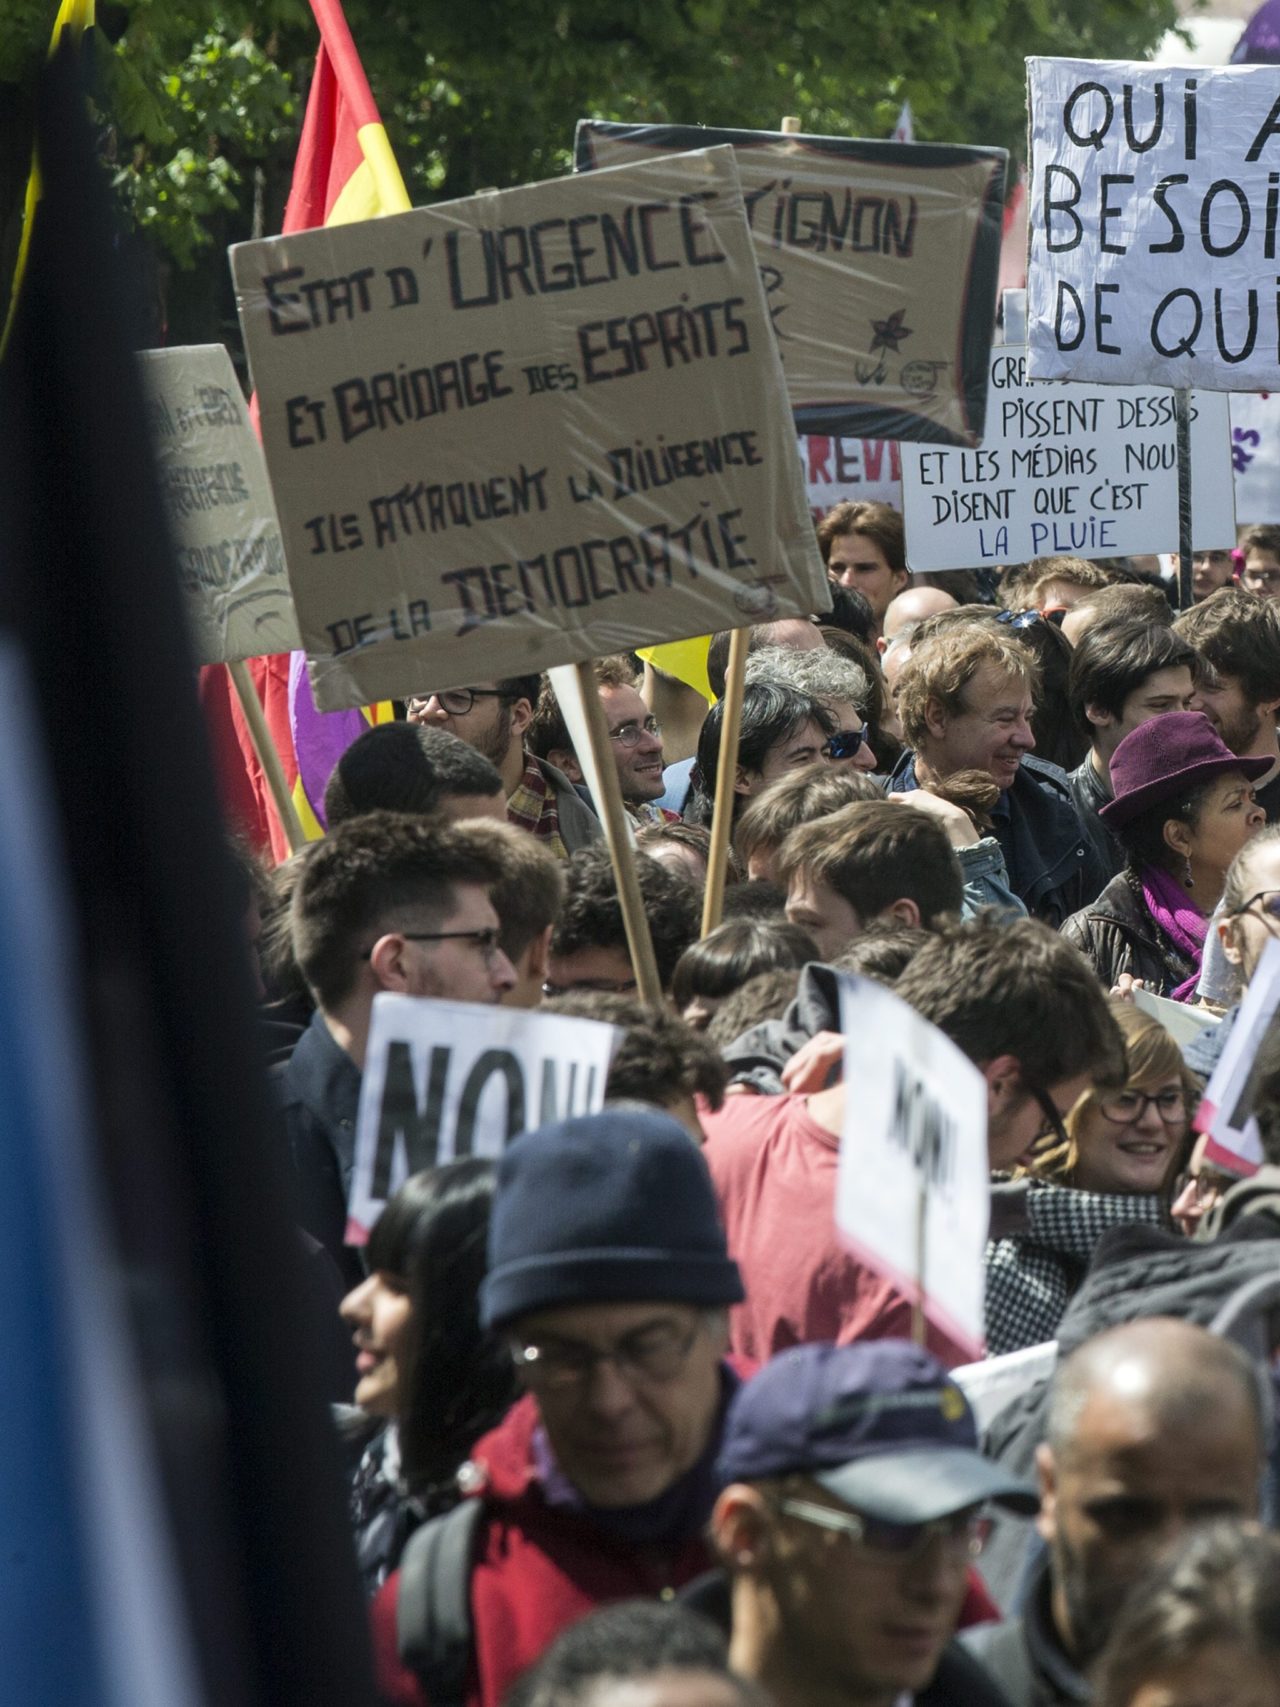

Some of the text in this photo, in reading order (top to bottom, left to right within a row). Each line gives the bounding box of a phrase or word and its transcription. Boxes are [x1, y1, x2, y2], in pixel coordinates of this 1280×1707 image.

[1054, 281, 1121, 354] DE
[285, 396, 327, 449] ET
[521, 364, 578, 395] DES
[919, 451, 950, 485] ET
[961, 450, 1001, 484] LES
[1125, 443, 1177, 474] NOU
[368, 464, 548, 549] ATTAQUENT
[567, 466, 604, 503] LA
[1034, 487, 1080, 516] QUE
[1091, 478, 1150, 511] C'EST
[979, 526, 1009, 558] LA
[326, 614, 380, 657] DE
[390, 599, 431, 641] LA
